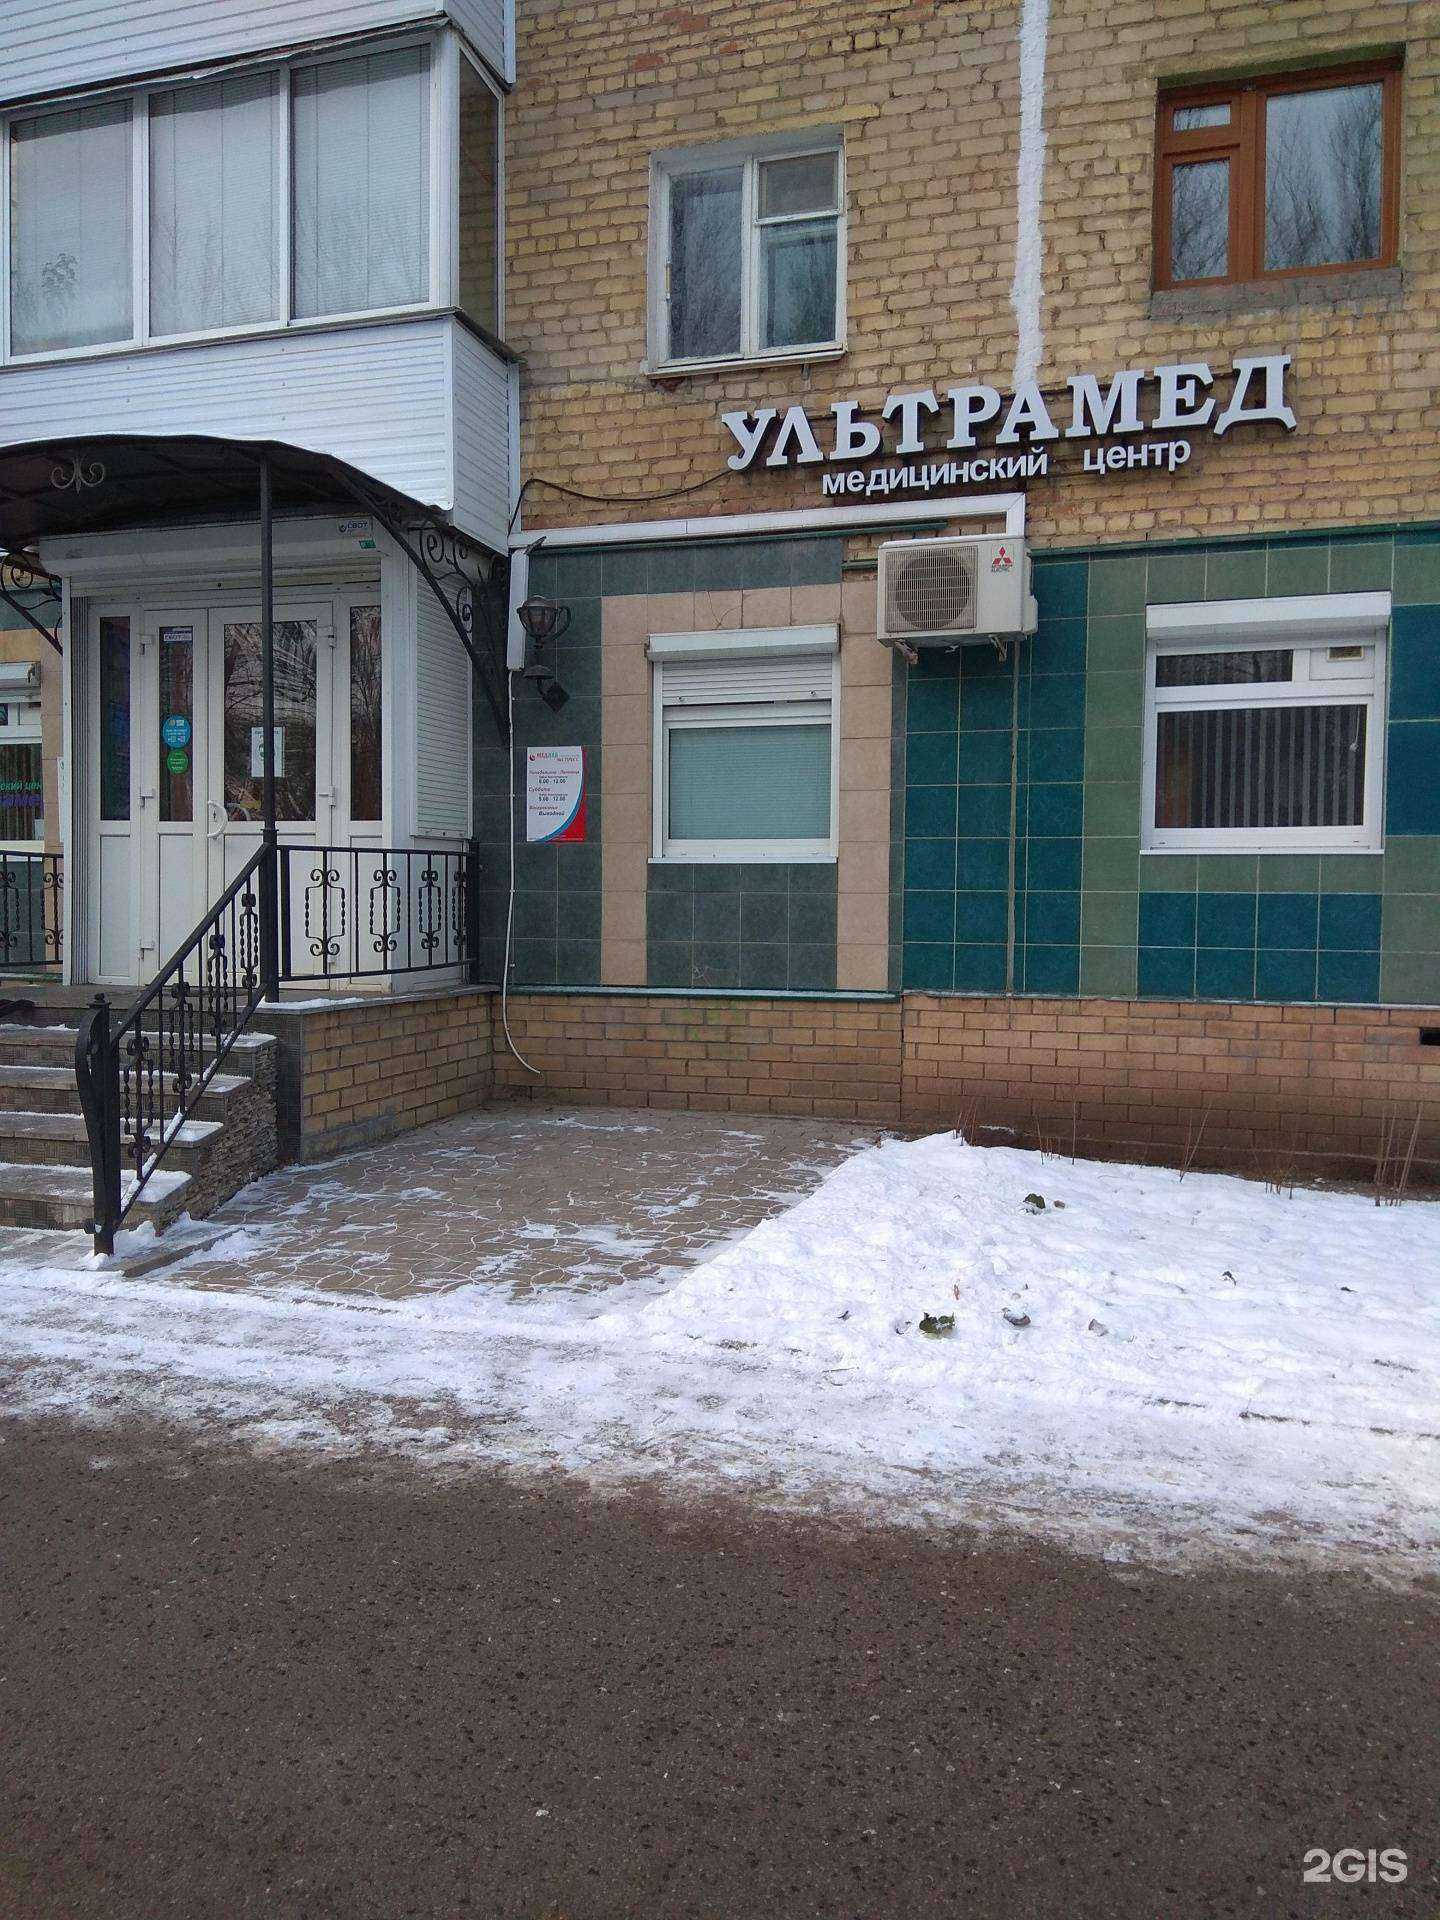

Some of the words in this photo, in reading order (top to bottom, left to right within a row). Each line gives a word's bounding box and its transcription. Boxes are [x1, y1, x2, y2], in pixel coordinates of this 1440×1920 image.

[721, 355, 1296, 471] УЛЬТРАМЕД
[822, 446, 1049, 496] медицинский
[1083, 439, 1191, 474] центр
